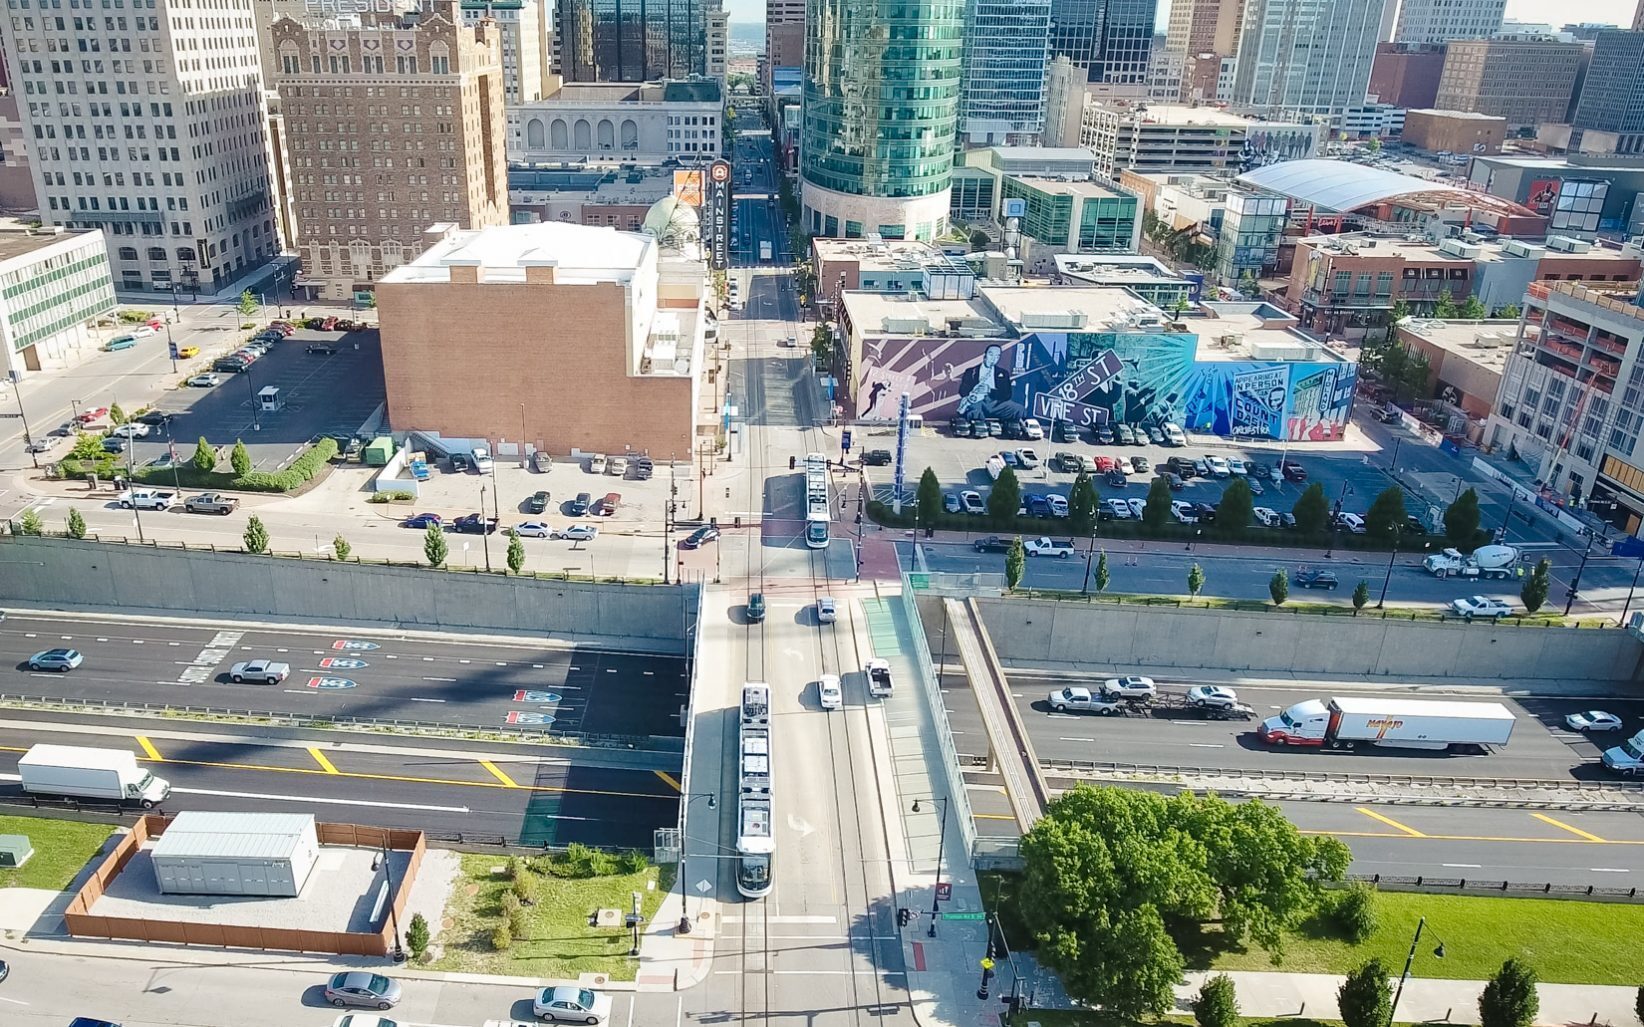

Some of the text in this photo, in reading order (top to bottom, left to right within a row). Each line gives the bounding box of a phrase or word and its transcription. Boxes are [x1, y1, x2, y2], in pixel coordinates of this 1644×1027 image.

[305, 0, 437, 13] PRESIDENT
[715, 182, 725, 268] MAINSTREET
[1059, 356, 1111, 401] 18TH ST
[1234, 378, 1284, 392] IN PERSON
[1041, 396, 1102, 426] VINE ST
[1235, 398, 1278, 424] COUNT
